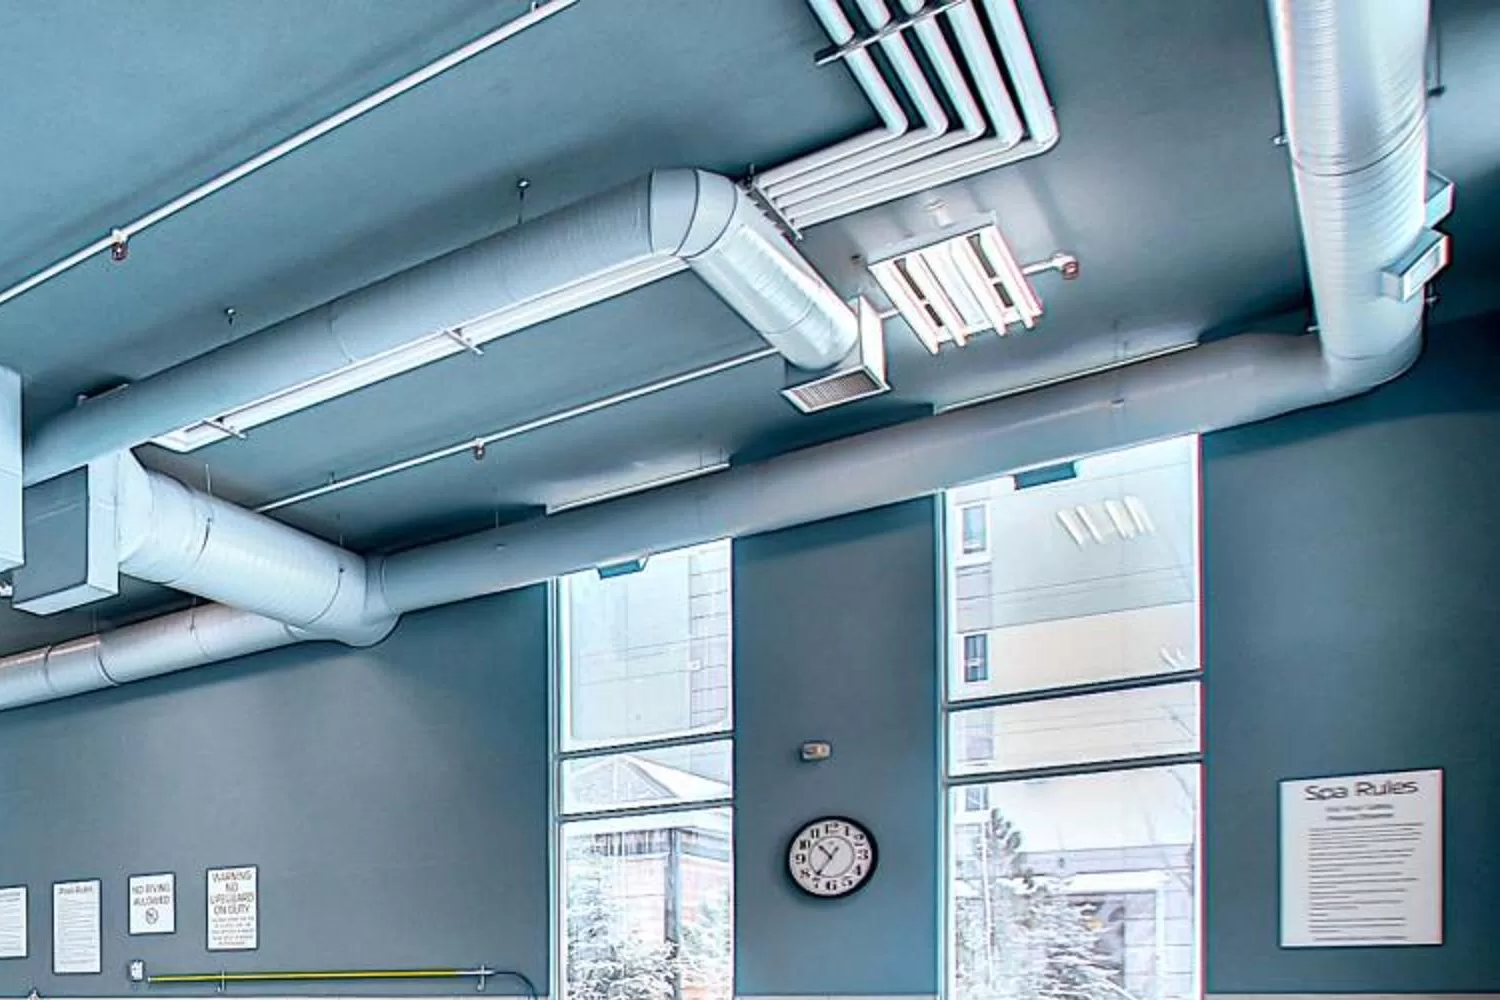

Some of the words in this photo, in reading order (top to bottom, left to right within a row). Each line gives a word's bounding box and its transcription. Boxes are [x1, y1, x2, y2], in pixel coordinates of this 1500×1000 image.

[1305, 785, 1348, 800] Spa
[1356, 780, 1419, 796] Rules
[796, 853, 806, 864] 9
[825, 880, 837, 891] 6
